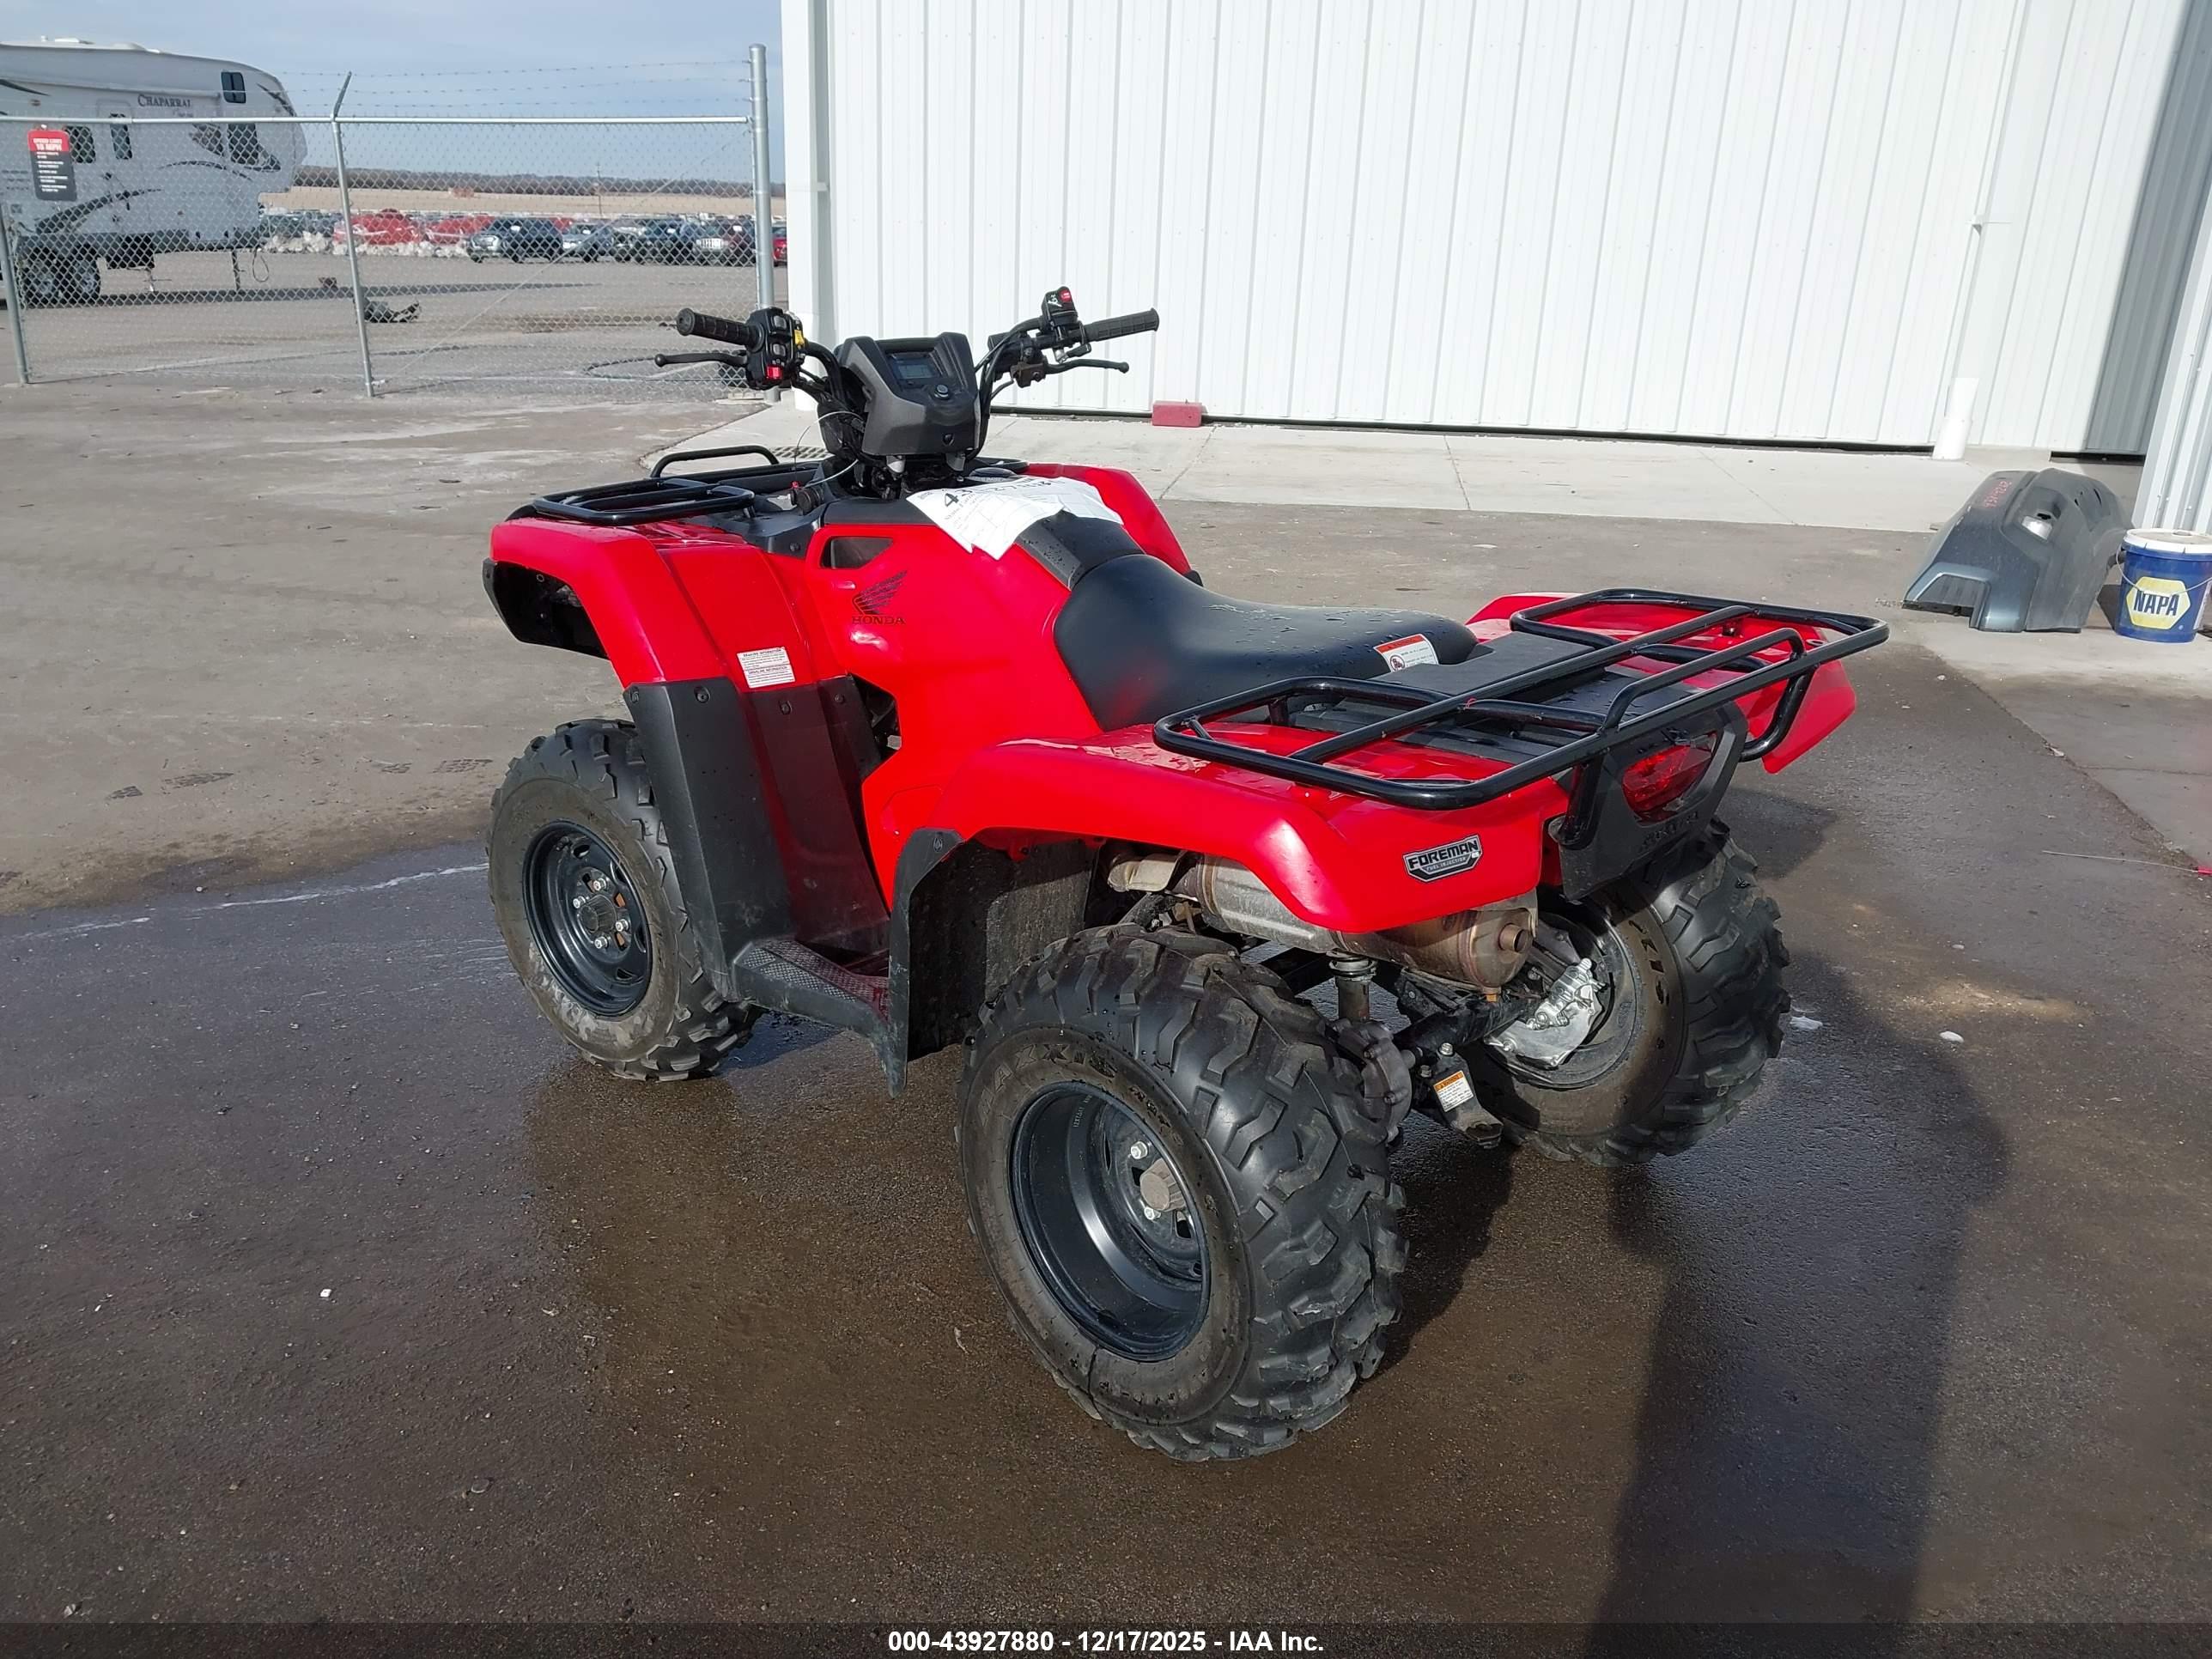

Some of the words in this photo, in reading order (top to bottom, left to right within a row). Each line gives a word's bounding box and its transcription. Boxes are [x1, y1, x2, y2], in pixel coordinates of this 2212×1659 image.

[2134, 590, 2179, 616] NAPA
[852, 615, 906, 625] HONDA
[1408, 840, 1479, 869] FOREMAN
[1425, 863, 1439, 872] FUEL
